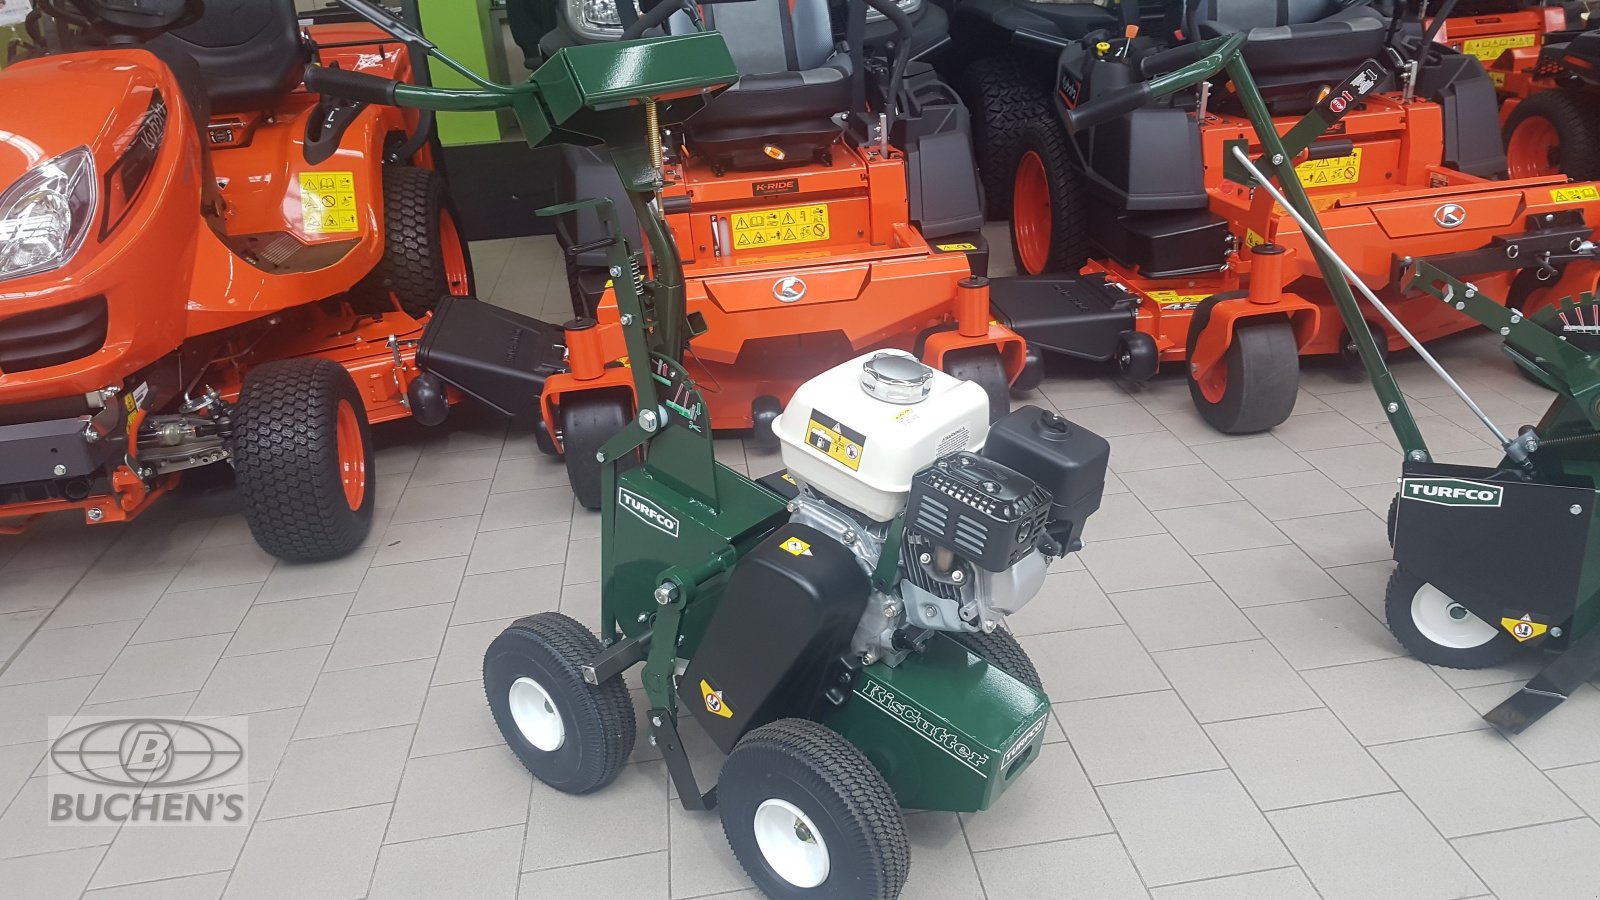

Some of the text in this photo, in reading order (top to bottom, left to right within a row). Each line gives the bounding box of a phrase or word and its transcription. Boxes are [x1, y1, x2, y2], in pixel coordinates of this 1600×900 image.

[1332, 99, 1344, 110] STOP
[756, 181, 793, 191] K-RIDE
[1409, 483, 1494, 501] TURFCO
[623, 493, 675, 530] TURFCO
[1006, 721, 1043, 761] TURFCO
